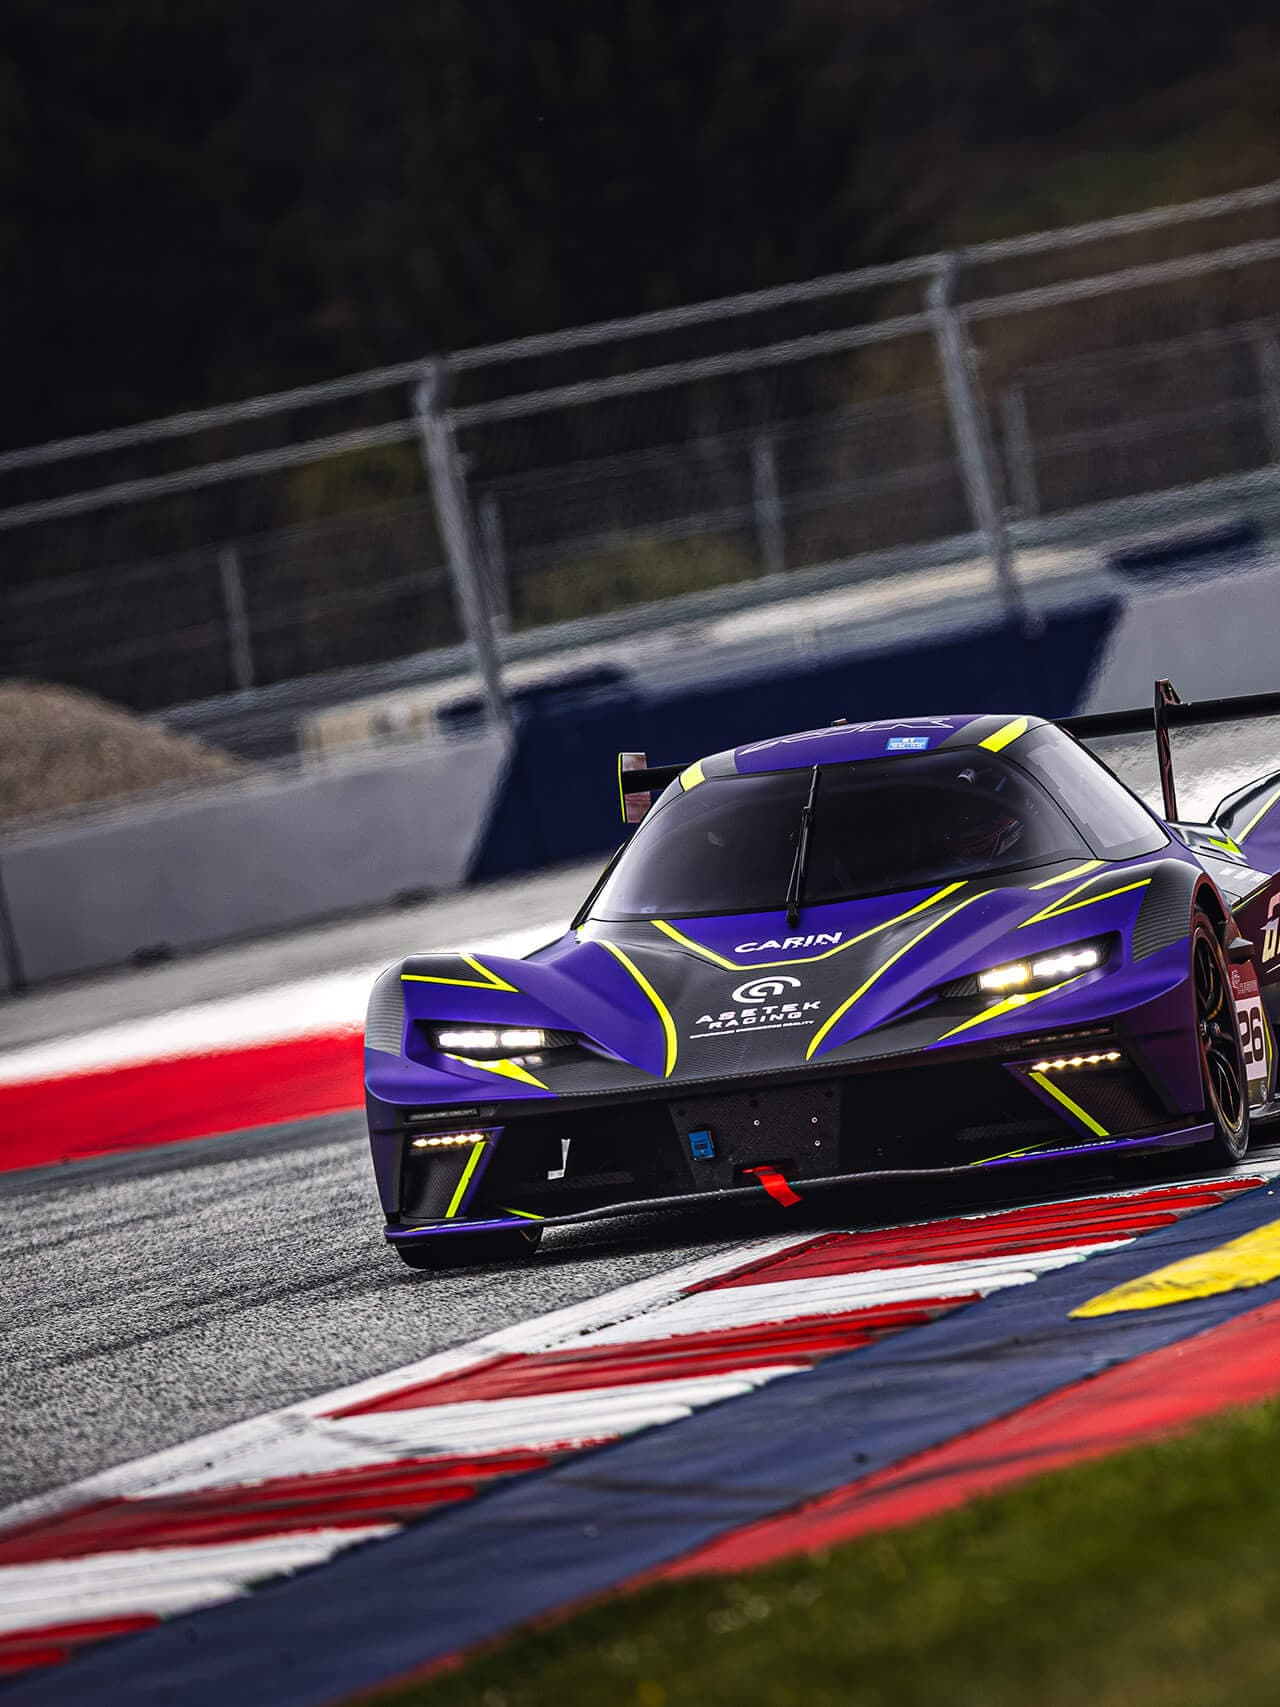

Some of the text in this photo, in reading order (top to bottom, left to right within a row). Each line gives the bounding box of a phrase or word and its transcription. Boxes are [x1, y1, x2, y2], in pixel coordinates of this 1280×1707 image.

[734, 931, 843, 953] CARIN
[695, 1001, 822, 1025] ASETEK
[708, 1011, 803, 1030] RACING
[1237, 1006, 1264, 1065] 26
